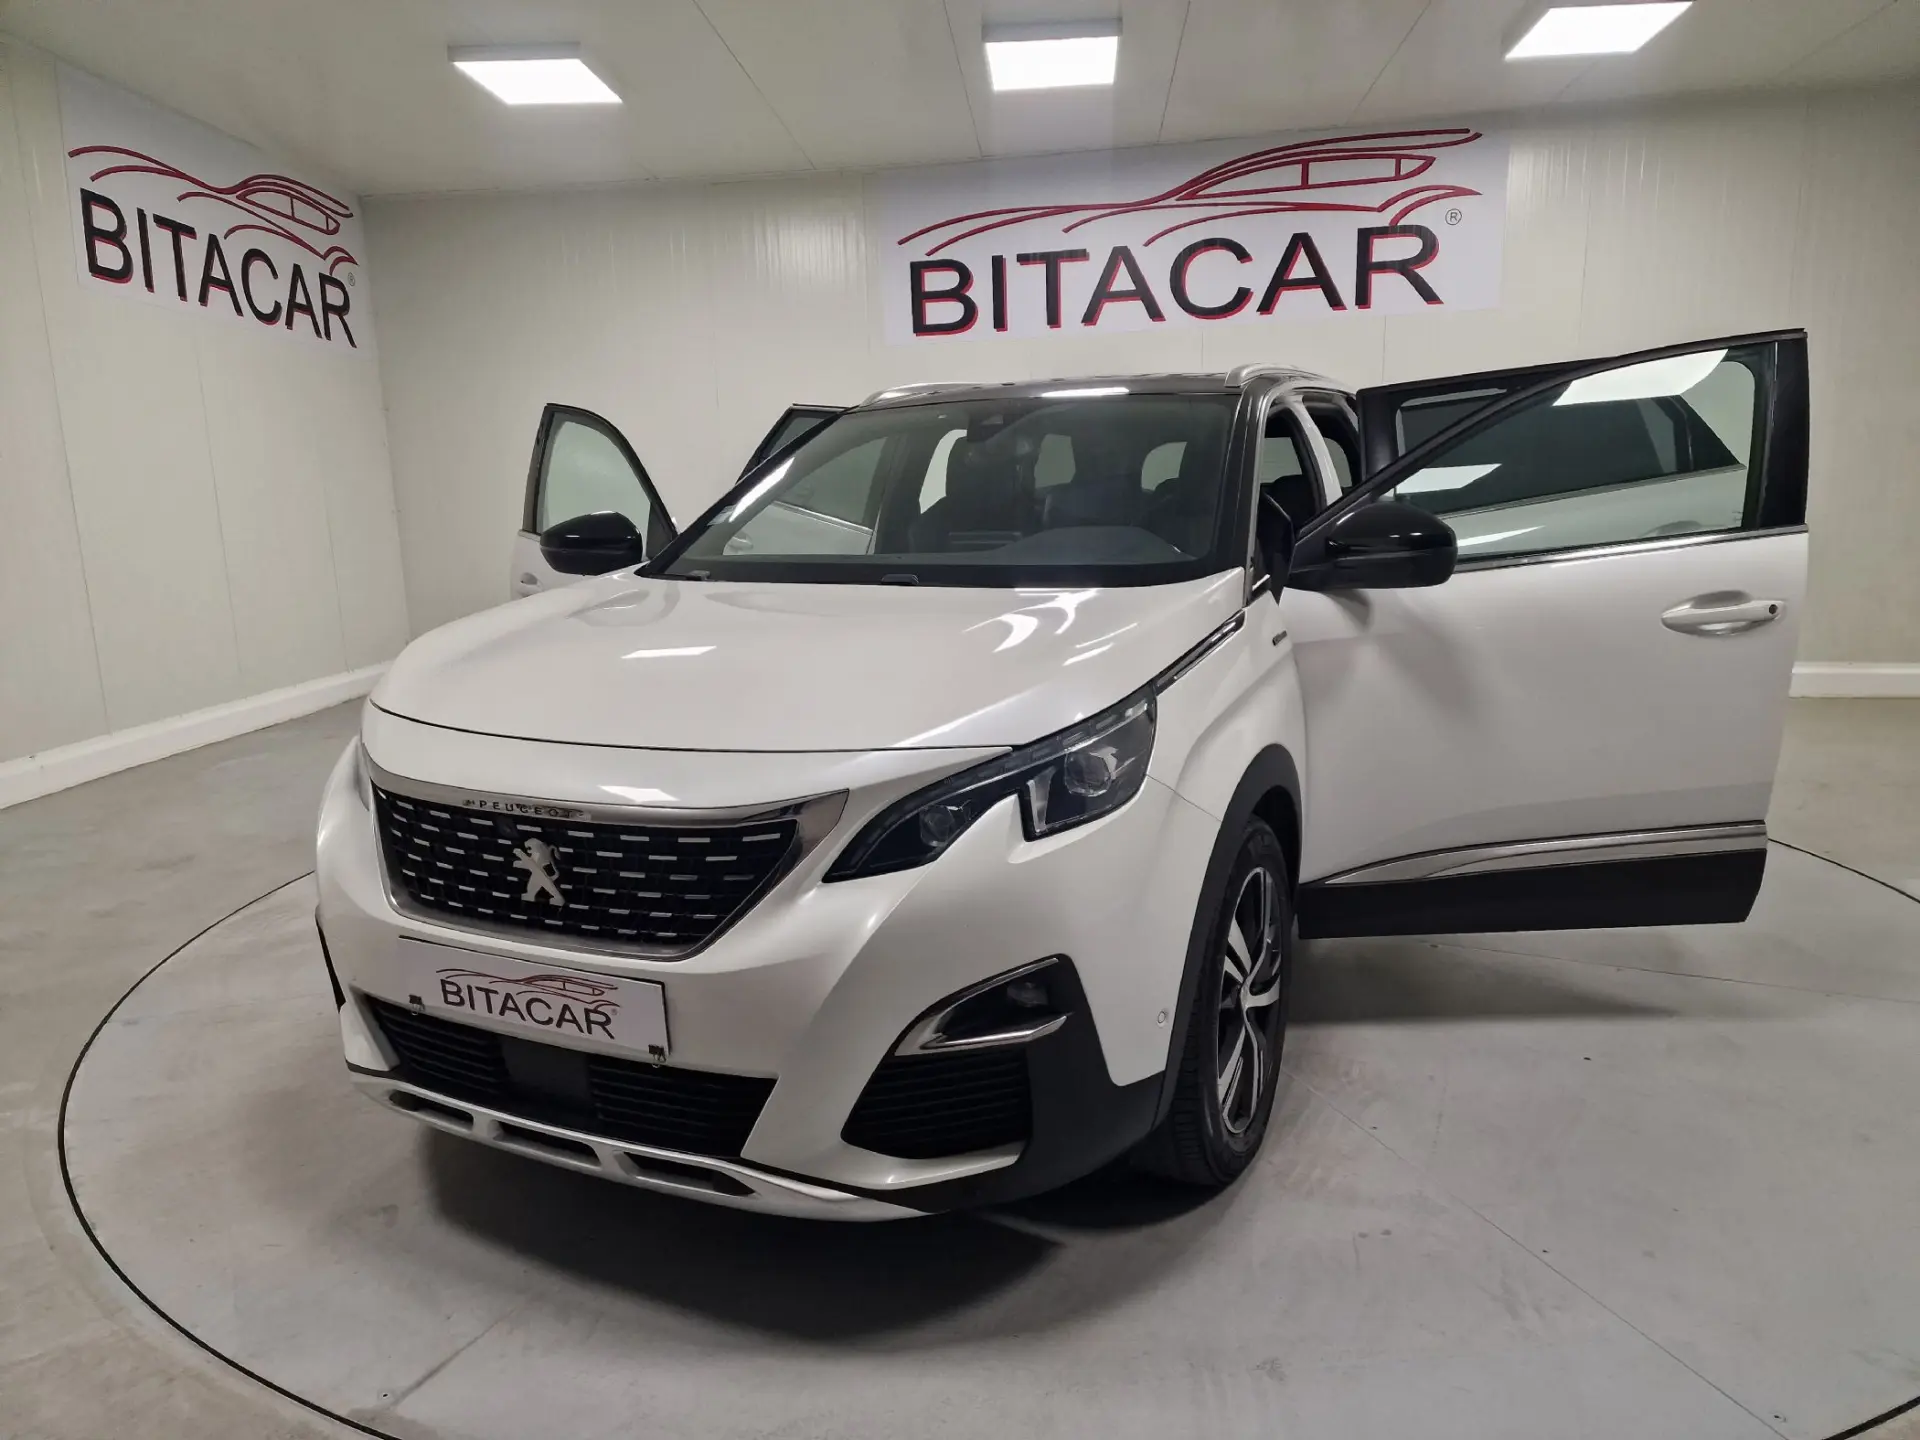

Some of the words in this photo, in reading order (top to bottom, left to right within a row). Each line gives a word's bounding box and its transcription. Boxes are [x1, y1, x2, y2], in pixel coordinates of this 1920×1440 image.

[80, 188, 357, 348] BITACAR
[910, 224, 1443, 336] BITACAR
[440, 979, 615, 1039] BITACAR
